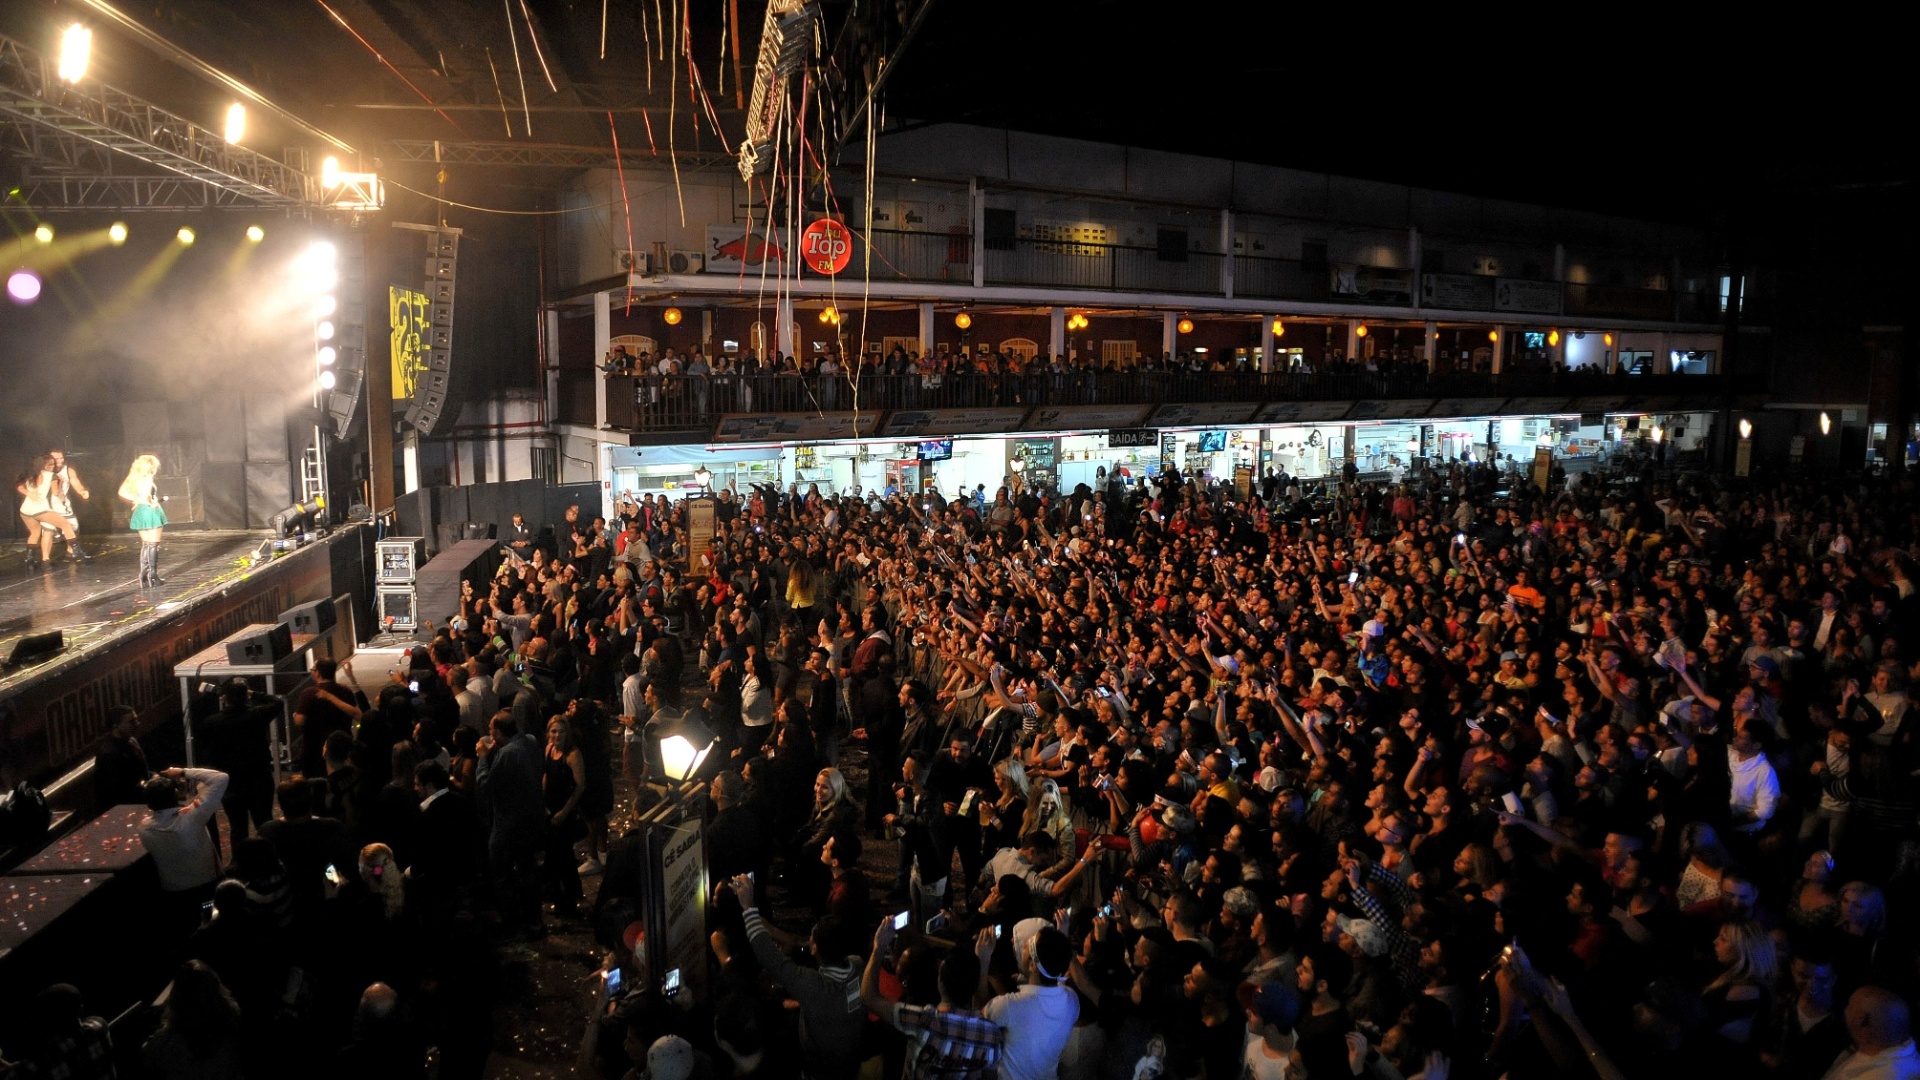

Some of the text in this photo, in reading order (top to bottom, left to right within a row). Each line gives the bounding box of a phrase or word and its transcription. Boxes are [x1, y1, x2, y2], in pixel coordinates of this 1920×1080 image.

[808, 232, 846, 260] Top
[818, 260, 833, 270] FM
[1110, 432, 1138, 444] SAÍDA
[664, 848, 675, 868] CÊ
